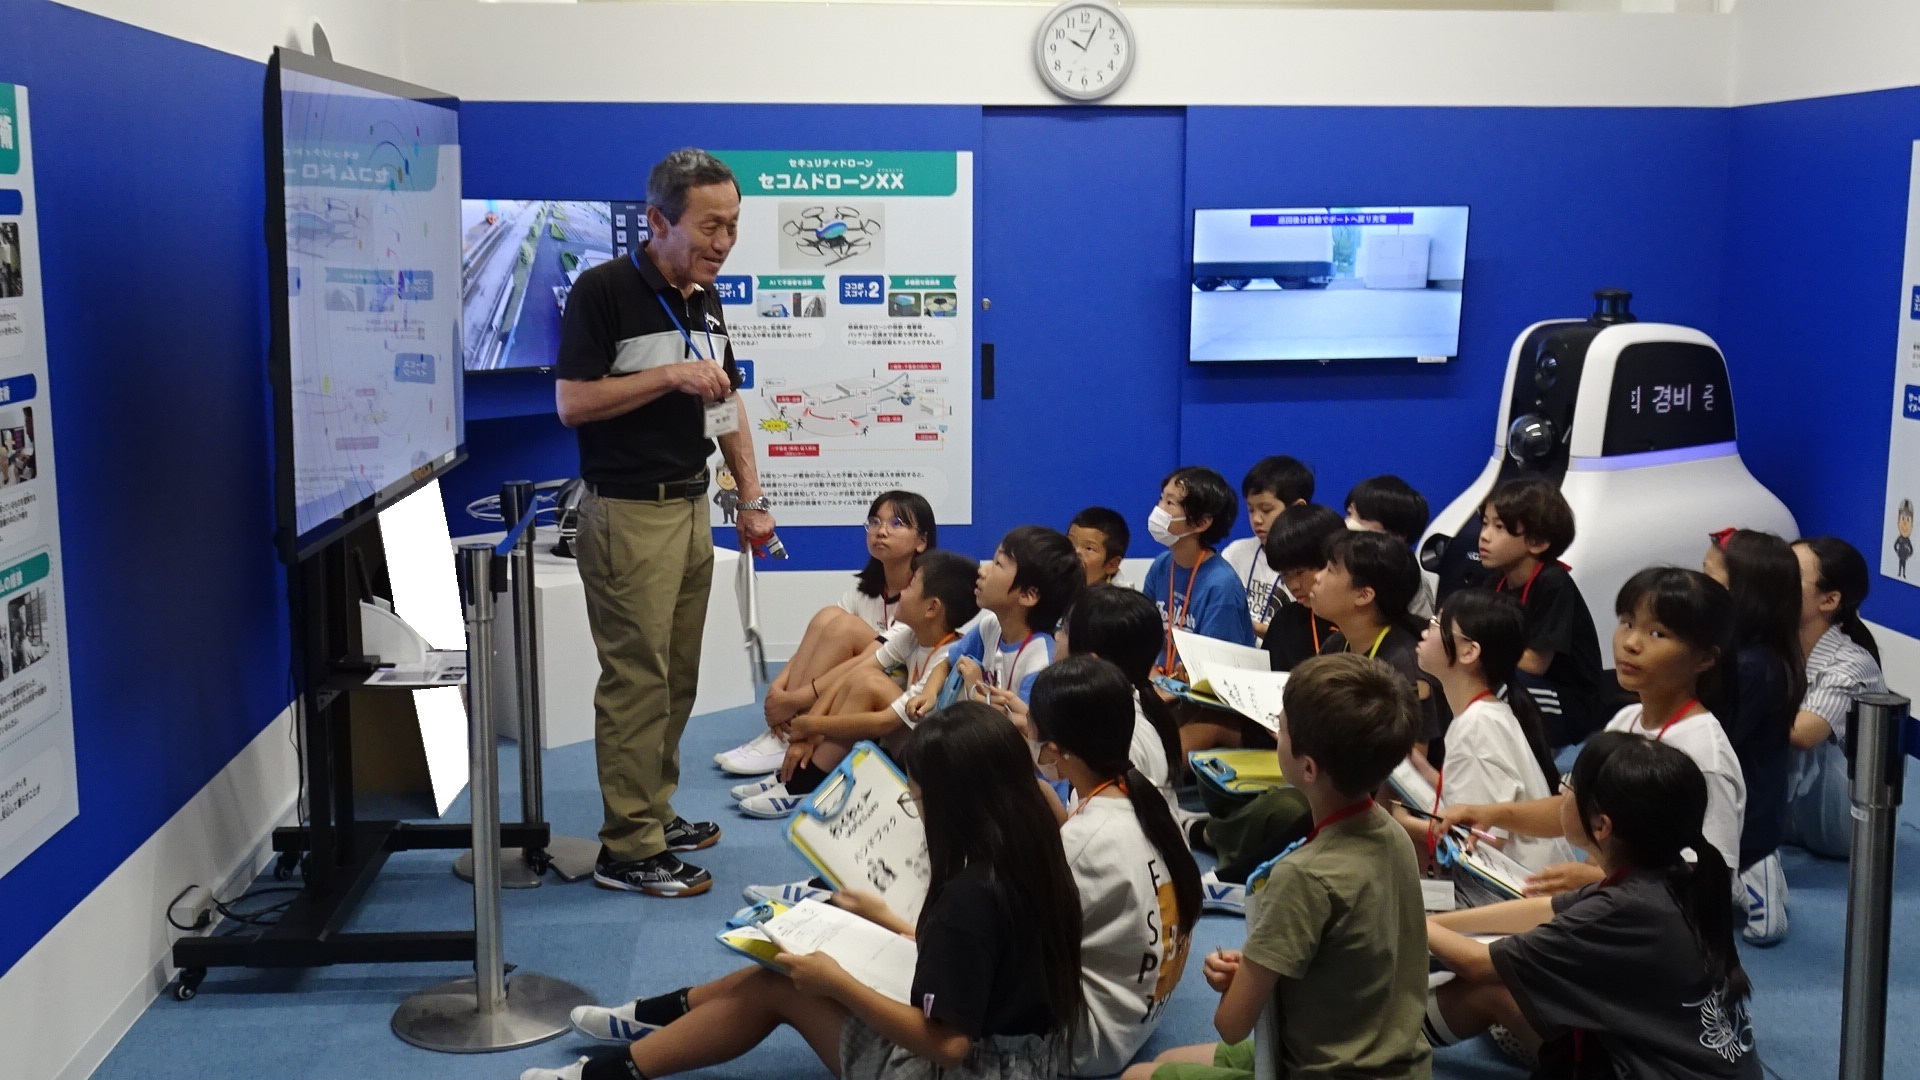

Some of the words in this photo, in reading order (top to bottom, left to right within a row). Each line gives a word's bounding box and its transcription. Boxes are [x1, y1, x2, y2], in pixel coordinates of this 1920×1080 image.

[1066, 17, 1076, 28] 11
[1080, 12, 1091, 24] 12
[1098, 17, 1103, 28] 1
[1055, 28, 1066, 40] 10
[1108, 28, 1116, 40] 2
[1049, 43, 1057, 55] 9
[1113, 43, 1120, 55] 3
[1054, 60, 1062, 71] 8
[1107, 59, 1115, 71] 4
[1066, 70, 1073, 82] 7
[1081, 75, 1088, 86] 6
[1096, 70, 1103, 82] 5
[788, 158, 873, 168] セキュリティドローン
[758, 172, 905, 190] セコムドローンXX
[737, 281, 746, 298] 1
[868, 281, 880, 298] 2
[1651, 383, 1692, 413] 경비
[1252, 579, 1273, 595] THE
[1248, 589, 1270, 605] RTH
